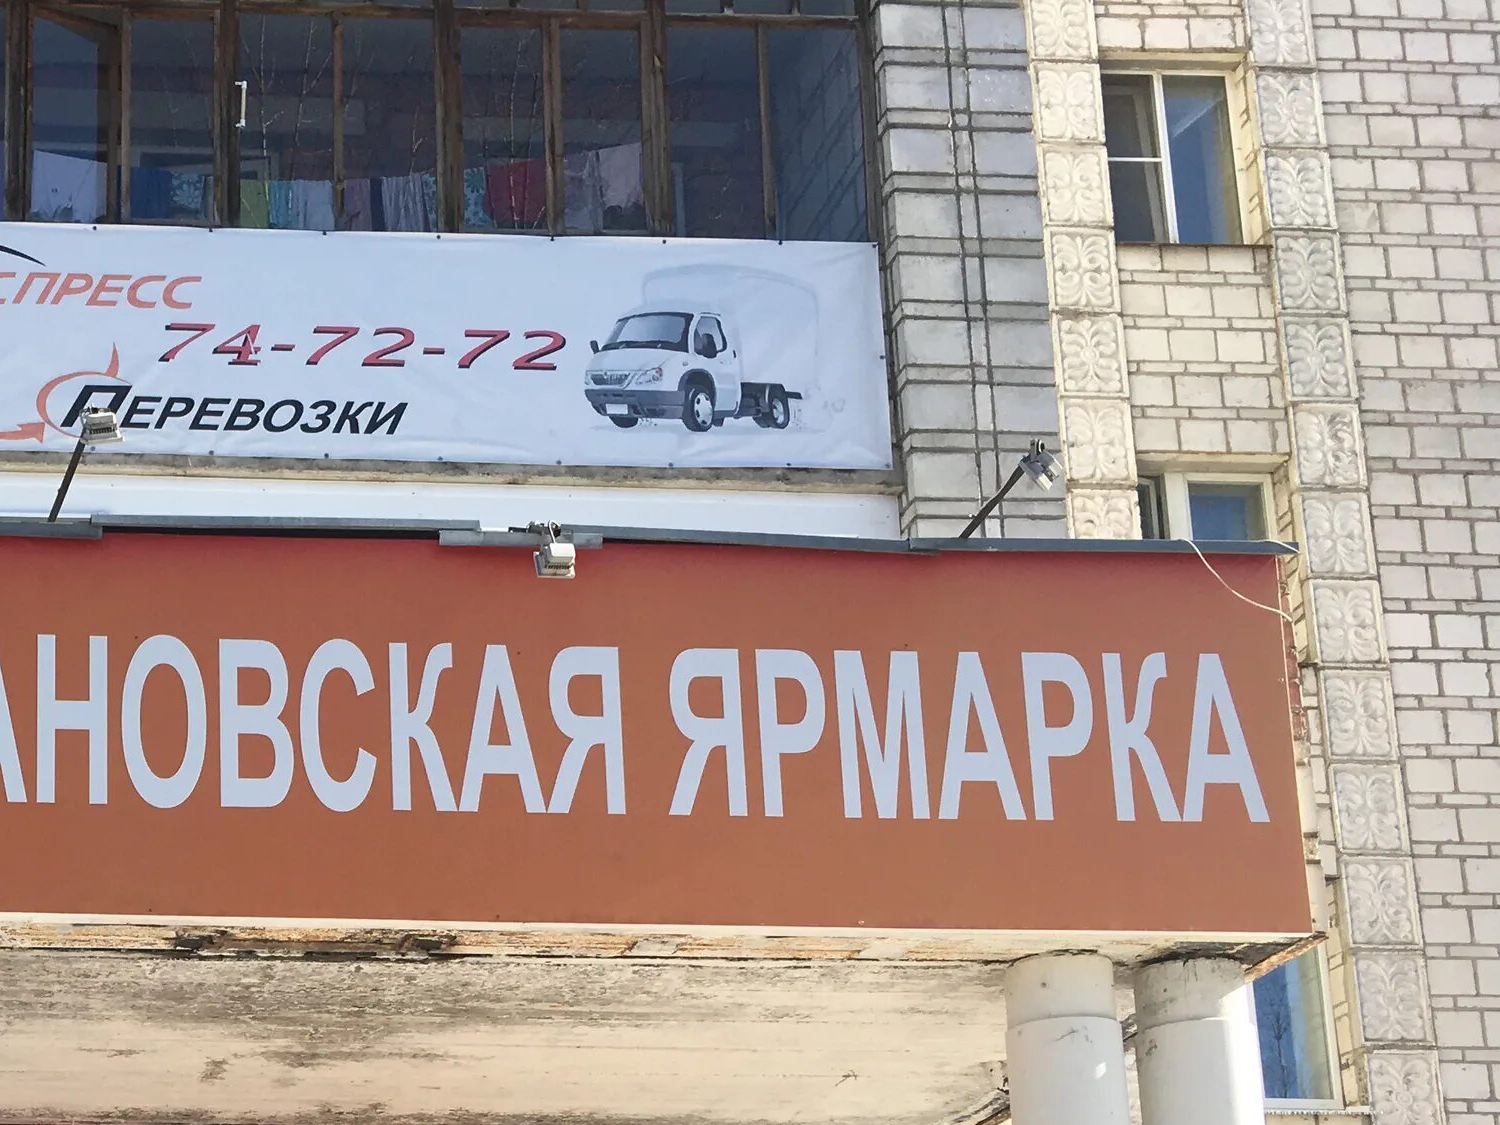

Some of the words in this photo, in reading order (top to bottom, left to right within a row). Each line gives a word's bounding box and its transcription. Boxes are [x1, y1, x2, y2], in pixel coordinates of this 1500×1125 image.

[158, 322, 567, 371] 74-72-72
[60, 385, 408, 436] ПЕРЕВОЗКИ
[668, 647, 1271, 823] ЯРМАРКА
